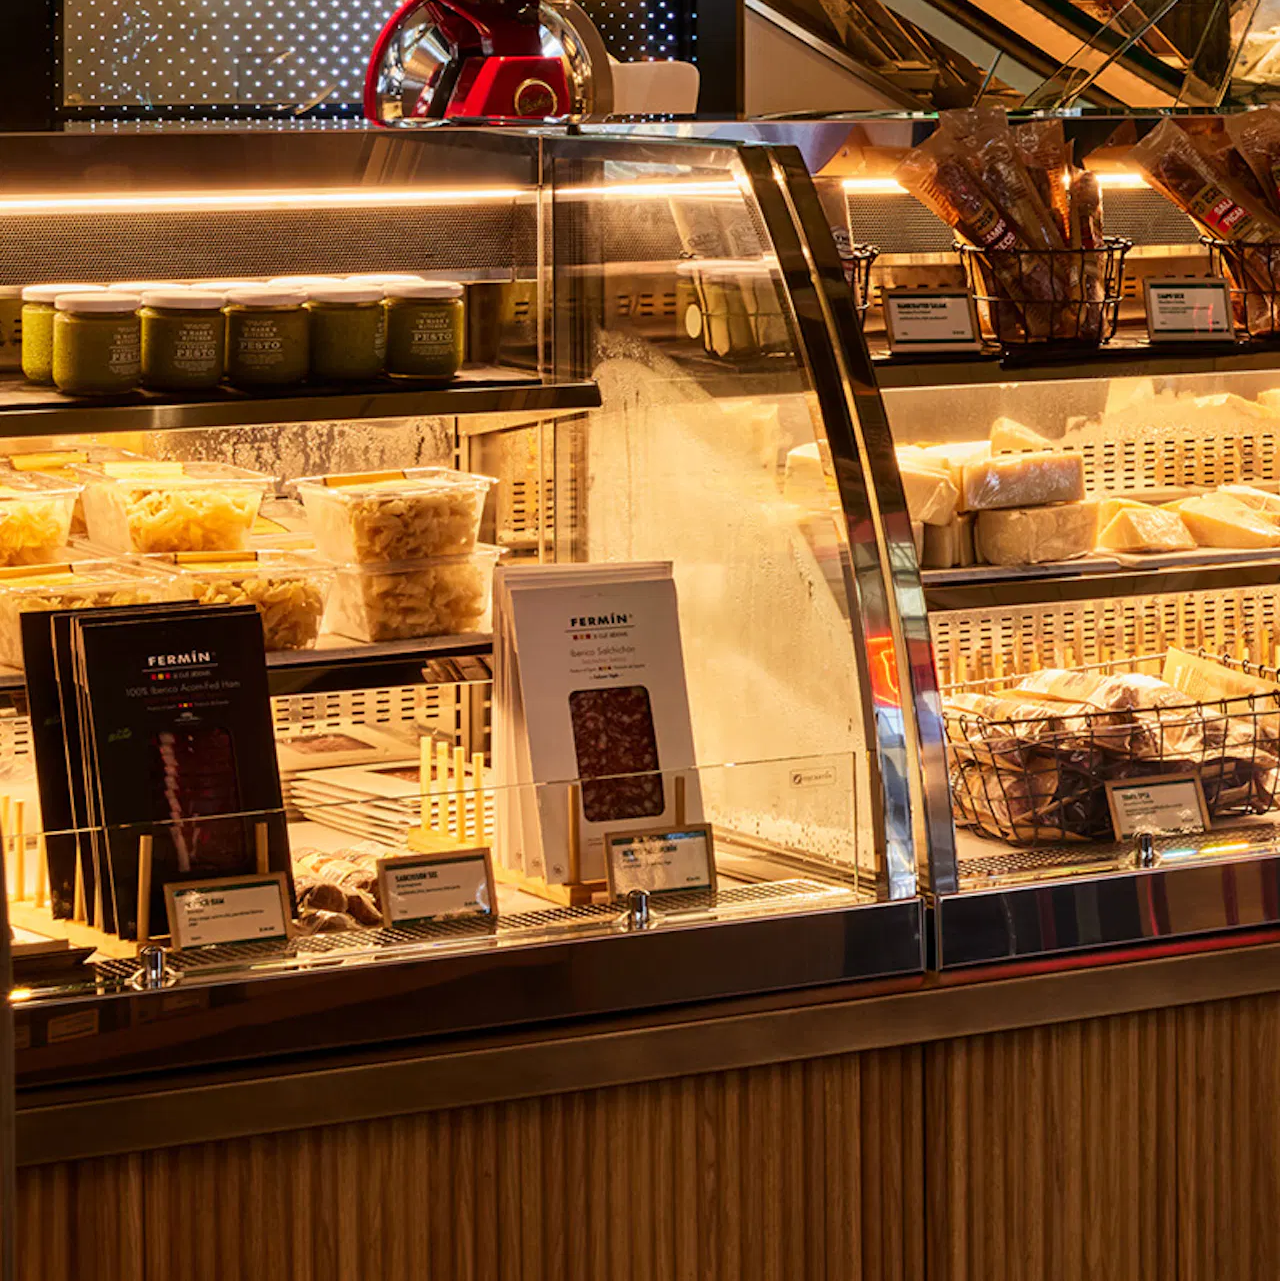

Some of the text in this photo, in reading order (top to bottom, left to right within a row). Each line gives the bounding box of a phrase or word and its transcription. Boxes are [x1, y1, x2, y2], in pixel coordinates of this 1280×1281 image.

[414, 333, 453, 341] PESTO
[240, 341, 281, 350] PESTO
[111, 352, 139, 362] PEST
[176, 349, 216, 358] PESTO
[570, 612, 628, 627] FERMÍN
[147, 649, 211, 667] FERMÍN
[125, 687, 149, 697] 100%
[221, 679, 241, 689] Ham
